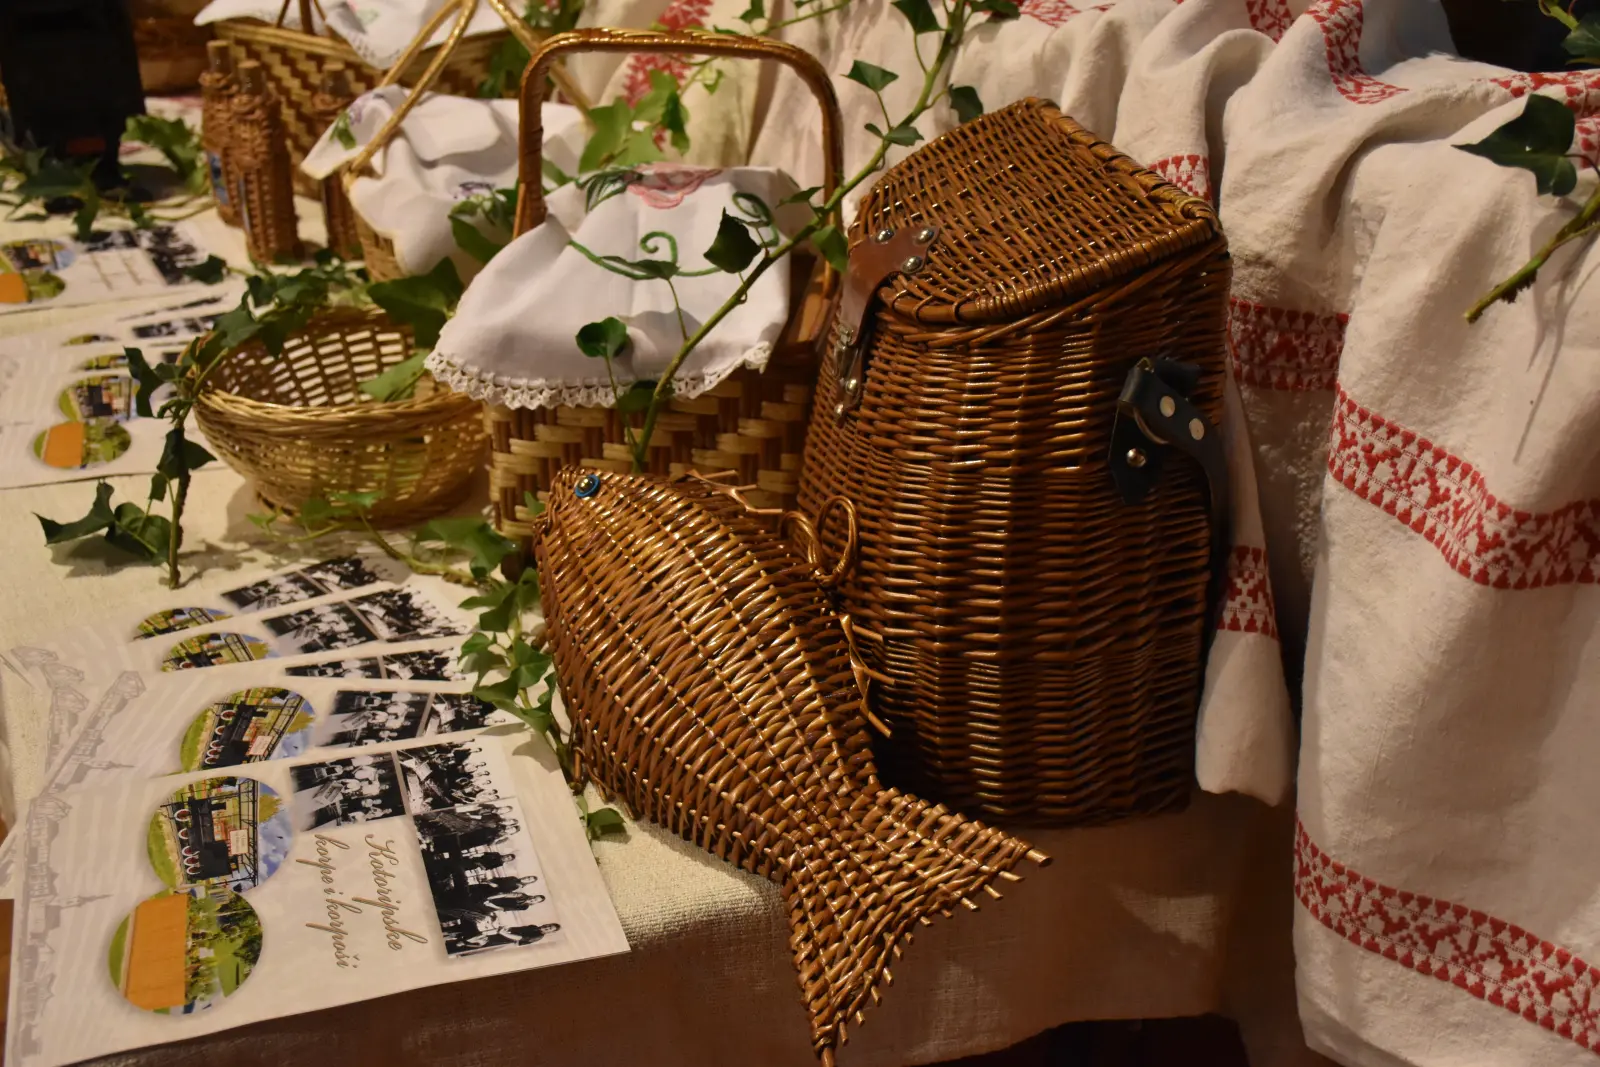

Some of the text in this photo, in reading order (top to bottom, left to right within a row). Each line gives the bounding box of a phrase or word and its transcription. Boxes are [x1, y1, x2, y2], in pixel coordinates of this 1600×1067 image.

[295, 834, 362, 968] korpe i korpoši
[352, 833, 428, 951] Kotoripske
